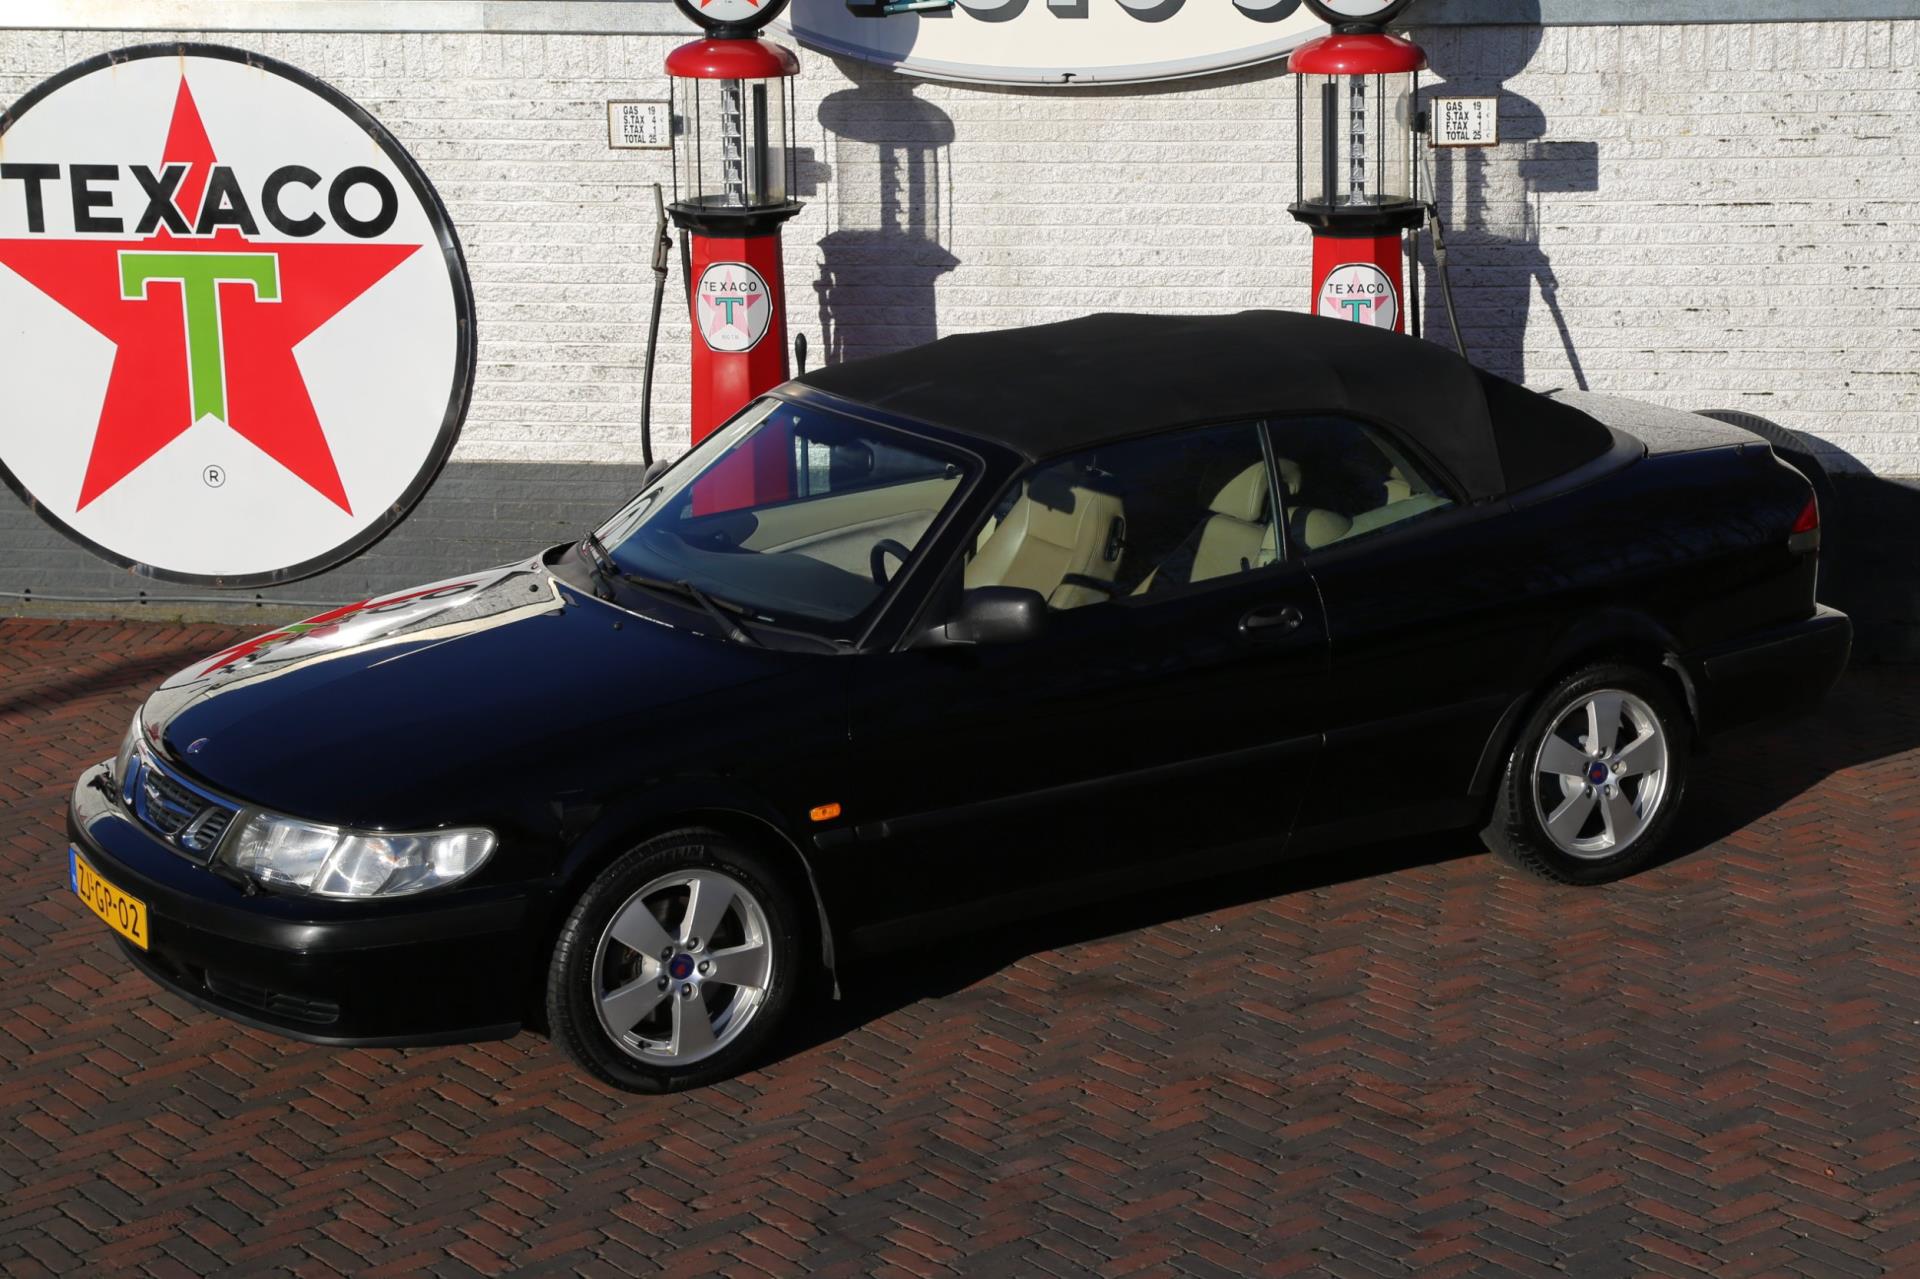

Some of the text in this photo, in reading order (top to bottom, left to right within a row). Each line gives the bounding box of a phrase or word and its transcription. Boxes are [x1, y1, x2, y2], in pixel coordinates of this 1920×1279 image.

[623, 105, 639, 115] GAS
[1446, 101, 1482, 111] GAS 19
[623, 115, 645, 124] S.TAX
[1446, 111, 1469, 121] S.TAX
[623, 125, 645, 134] F.TAX
[1446, 121, 1468, 130] F.TAX
[624, 134, 657, 144] TOTAL 25
[1446, 131, 1482, 140] TOTAL 25
[0, 162, 399, 238] TEXACO
[704, 281, 757, 292] TEXACO
[1328, 283, 1384, 294] TEXACO
[715, 297, 744, 325] T
[1341, 299, 1371, 324] T
[119, 252, 280, 422] T
[78, 863, 140, 938] ZJ-GP-02
